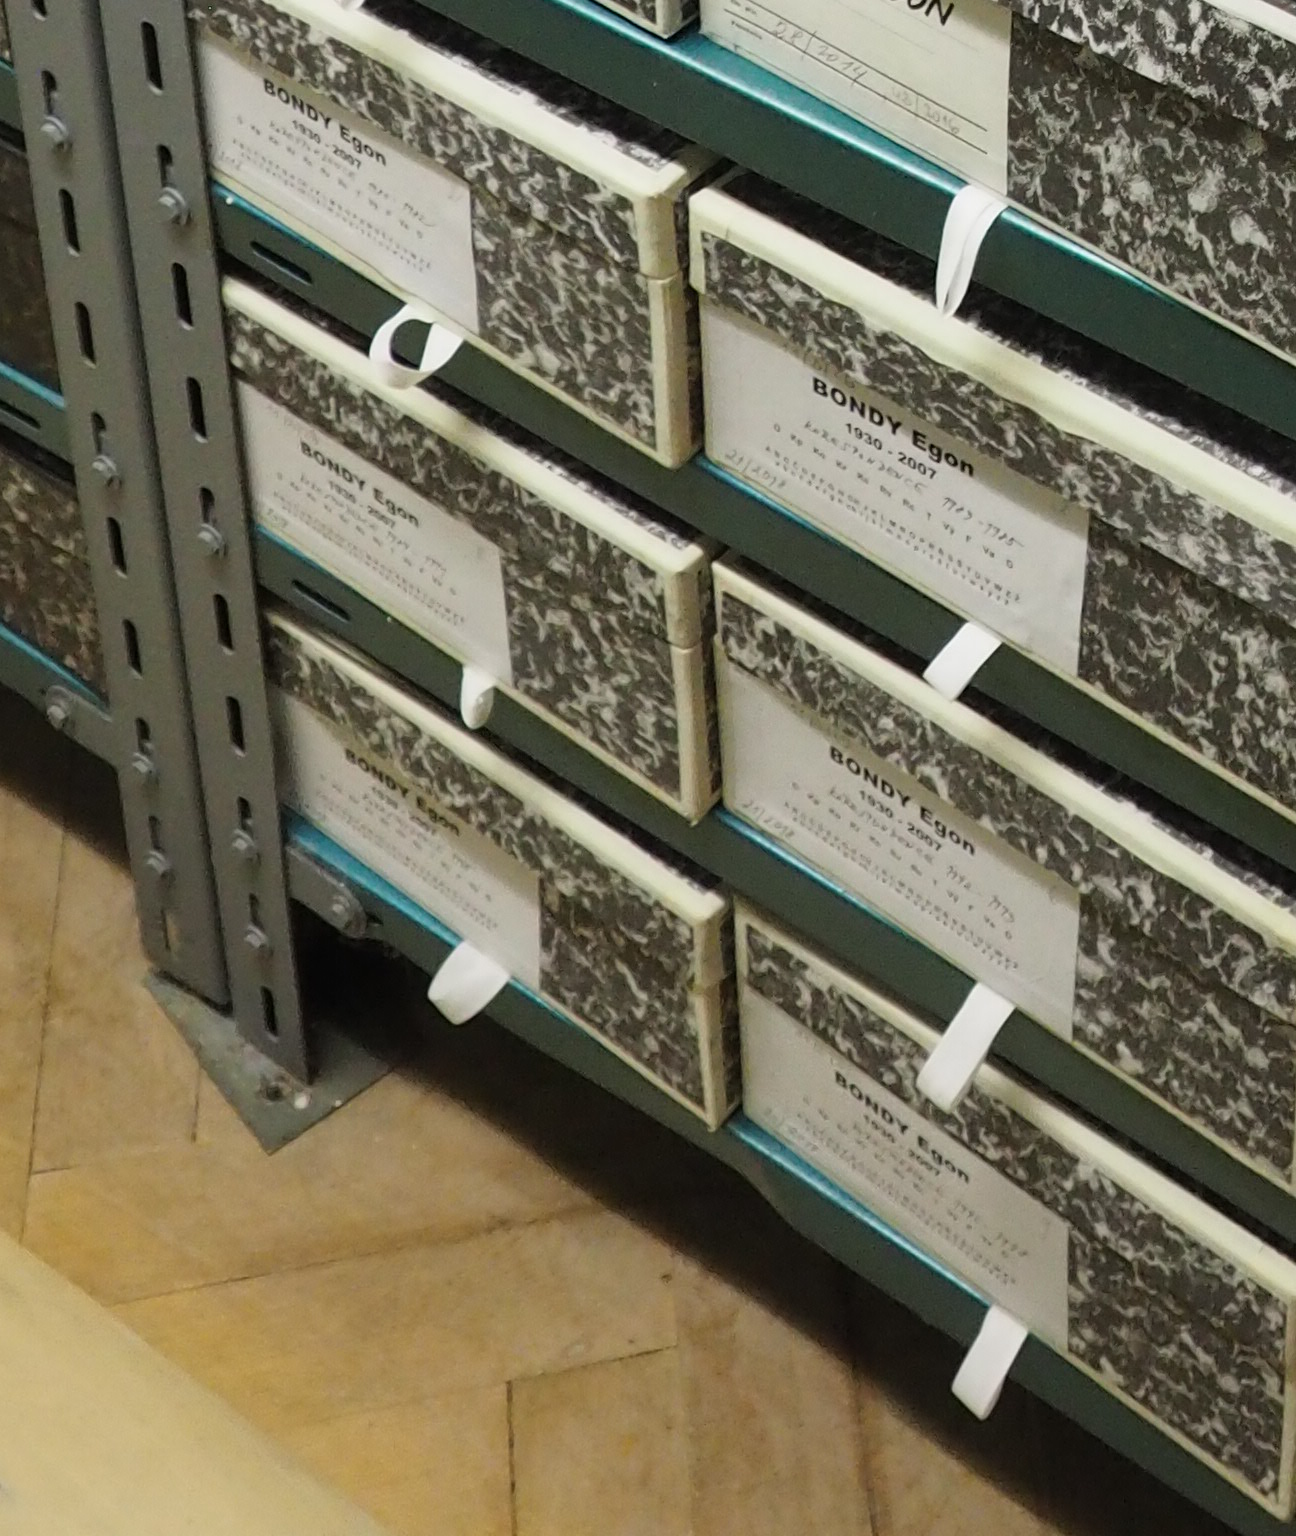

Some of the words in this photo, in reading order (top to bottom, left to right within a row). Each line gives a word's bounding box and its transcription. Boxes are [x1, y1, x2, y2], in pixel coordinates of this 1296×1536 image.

[263, 78, 332, 129] BONDY
[339, 123, 387, 166] Egon
[812, 376, 903, 436] BONDY
[911, 429, 975, 477] Egon
[845, 422, 883, 451] 1930
[898, 451, 937, 480] 2007
[300, 442, 366, 492] BONDY
[372, 487, 420, 527] Egon
[345, 748, 410, 797] BONDY
[829, 745, 911, 809] BONDY
[920, 804, 976, 857] Egon
[834, 1071, 909, 1135] BONDY
[917, 1135, 970, 1184] Egon
